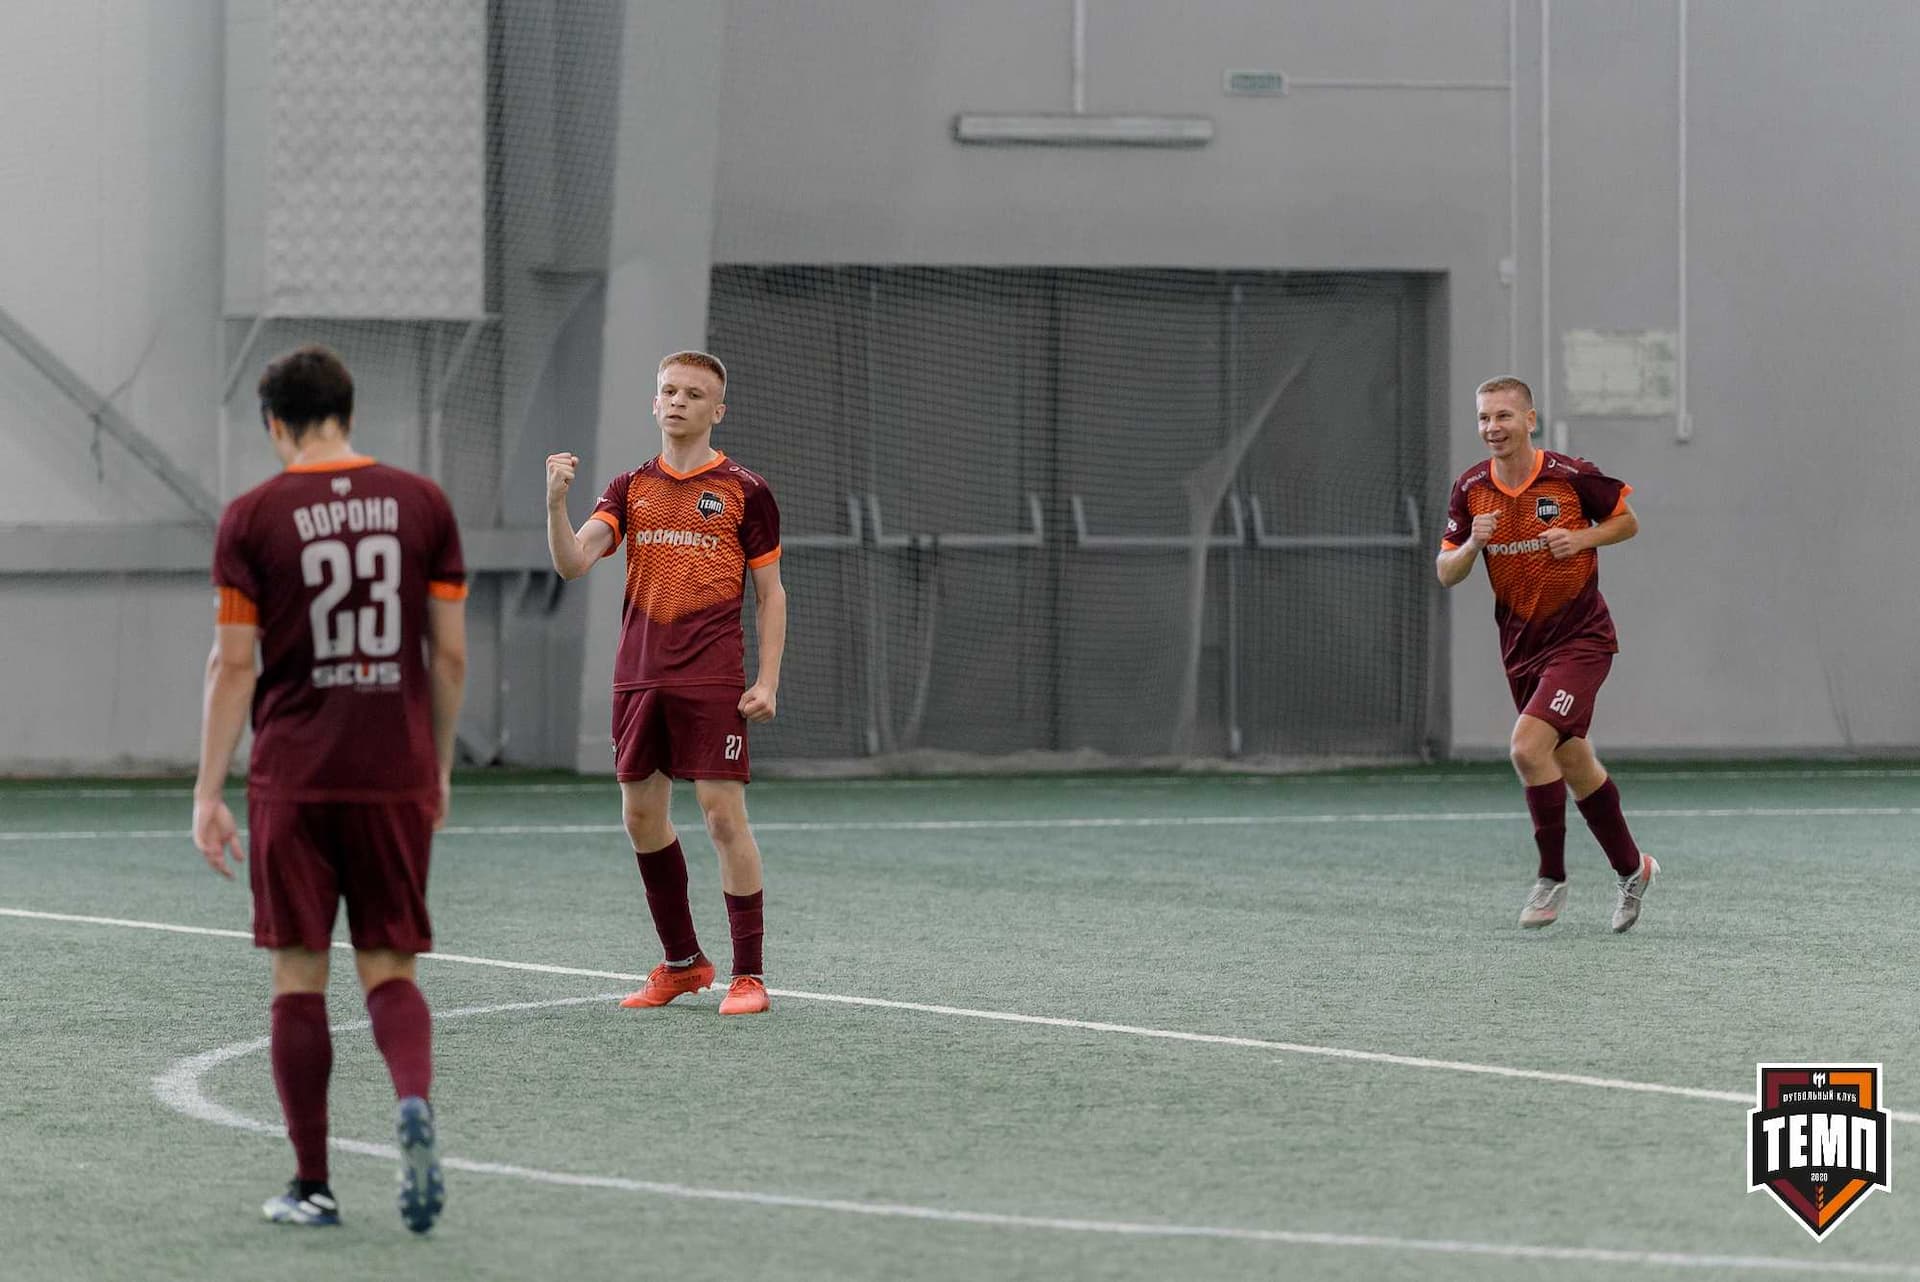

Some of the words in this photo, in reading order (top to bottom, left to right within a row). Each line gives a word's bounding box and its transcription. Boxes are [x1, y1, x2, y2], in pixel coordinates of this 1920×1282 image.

[293, 497, 399, 541] ВОРОНА
[700, 499, 722, 513] ТЕМП
[301, 534, 401, 660] 23
[1550, 689, 1574, 716] 20
[725, 735, 742, 760] 27
